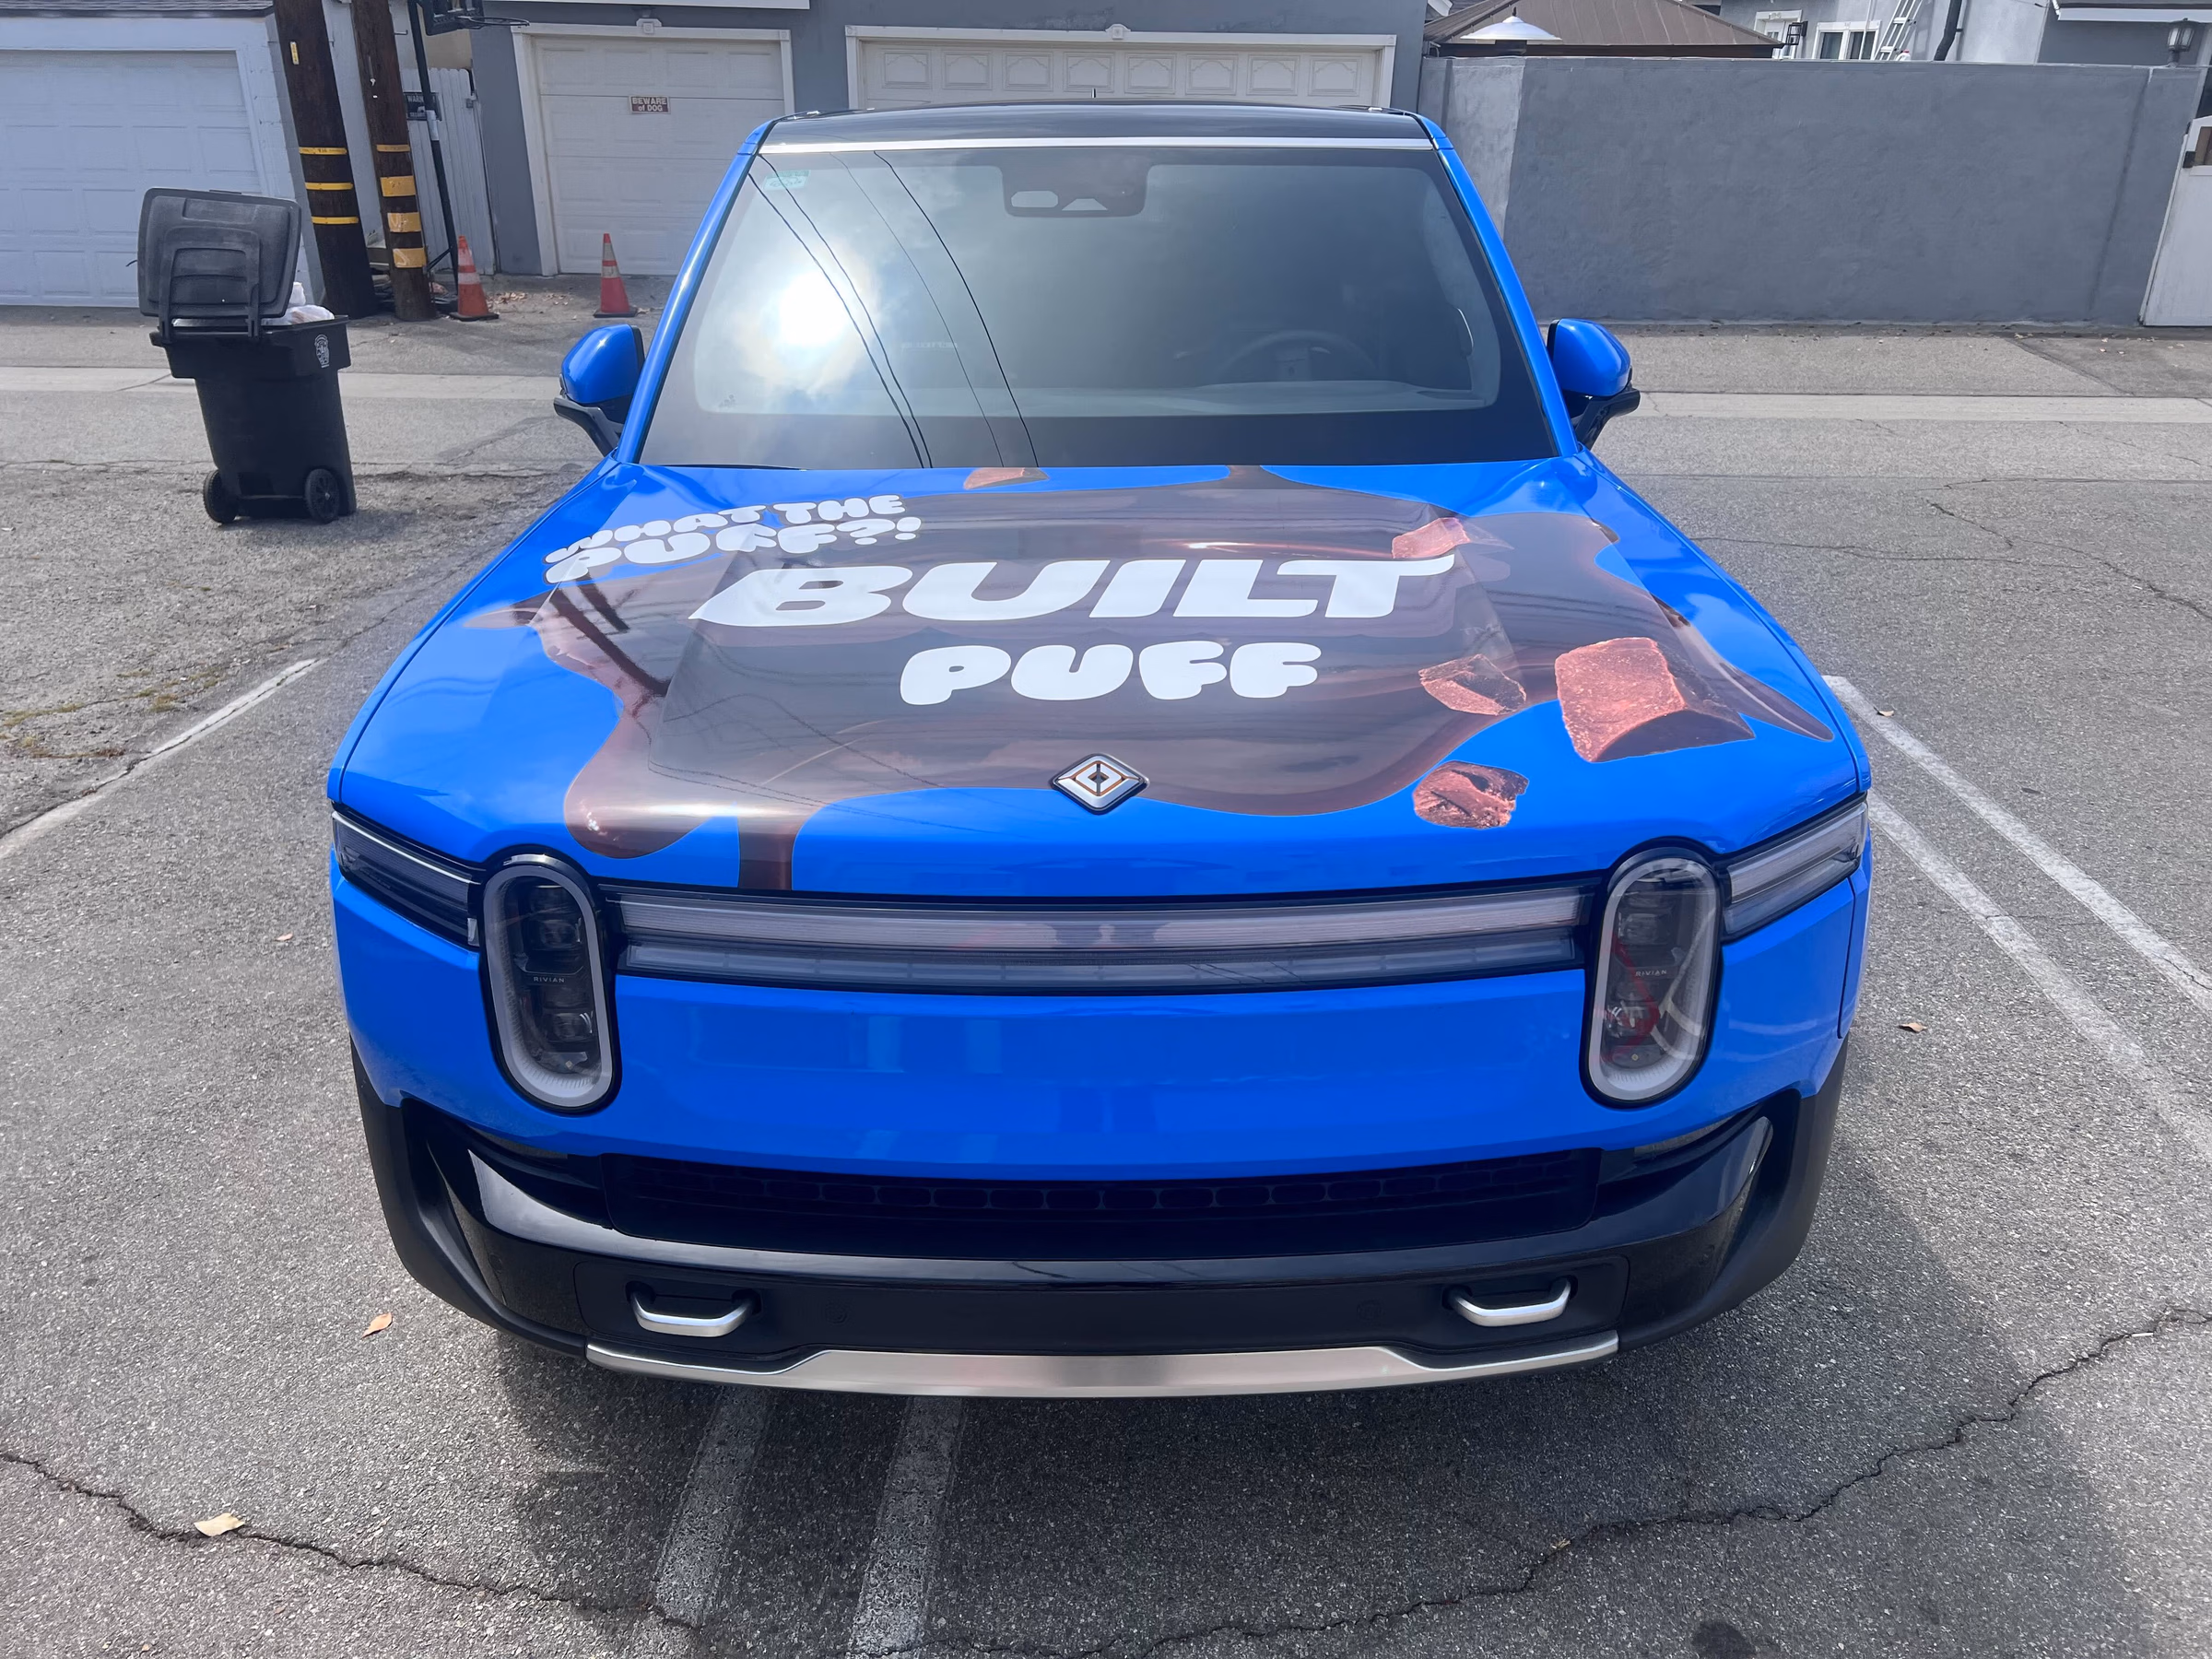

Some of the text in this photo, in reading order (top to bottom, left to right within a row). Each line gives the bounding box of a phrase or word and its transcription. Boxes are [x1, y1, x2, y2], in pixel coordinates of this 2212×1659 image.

[544, 494, 906, 563] WHAT THE
[545, 516, 922, 584] PUFF?!
[688, 554, 1455, 628] BUILT
[900, 641, 1322, 705] PUFF
